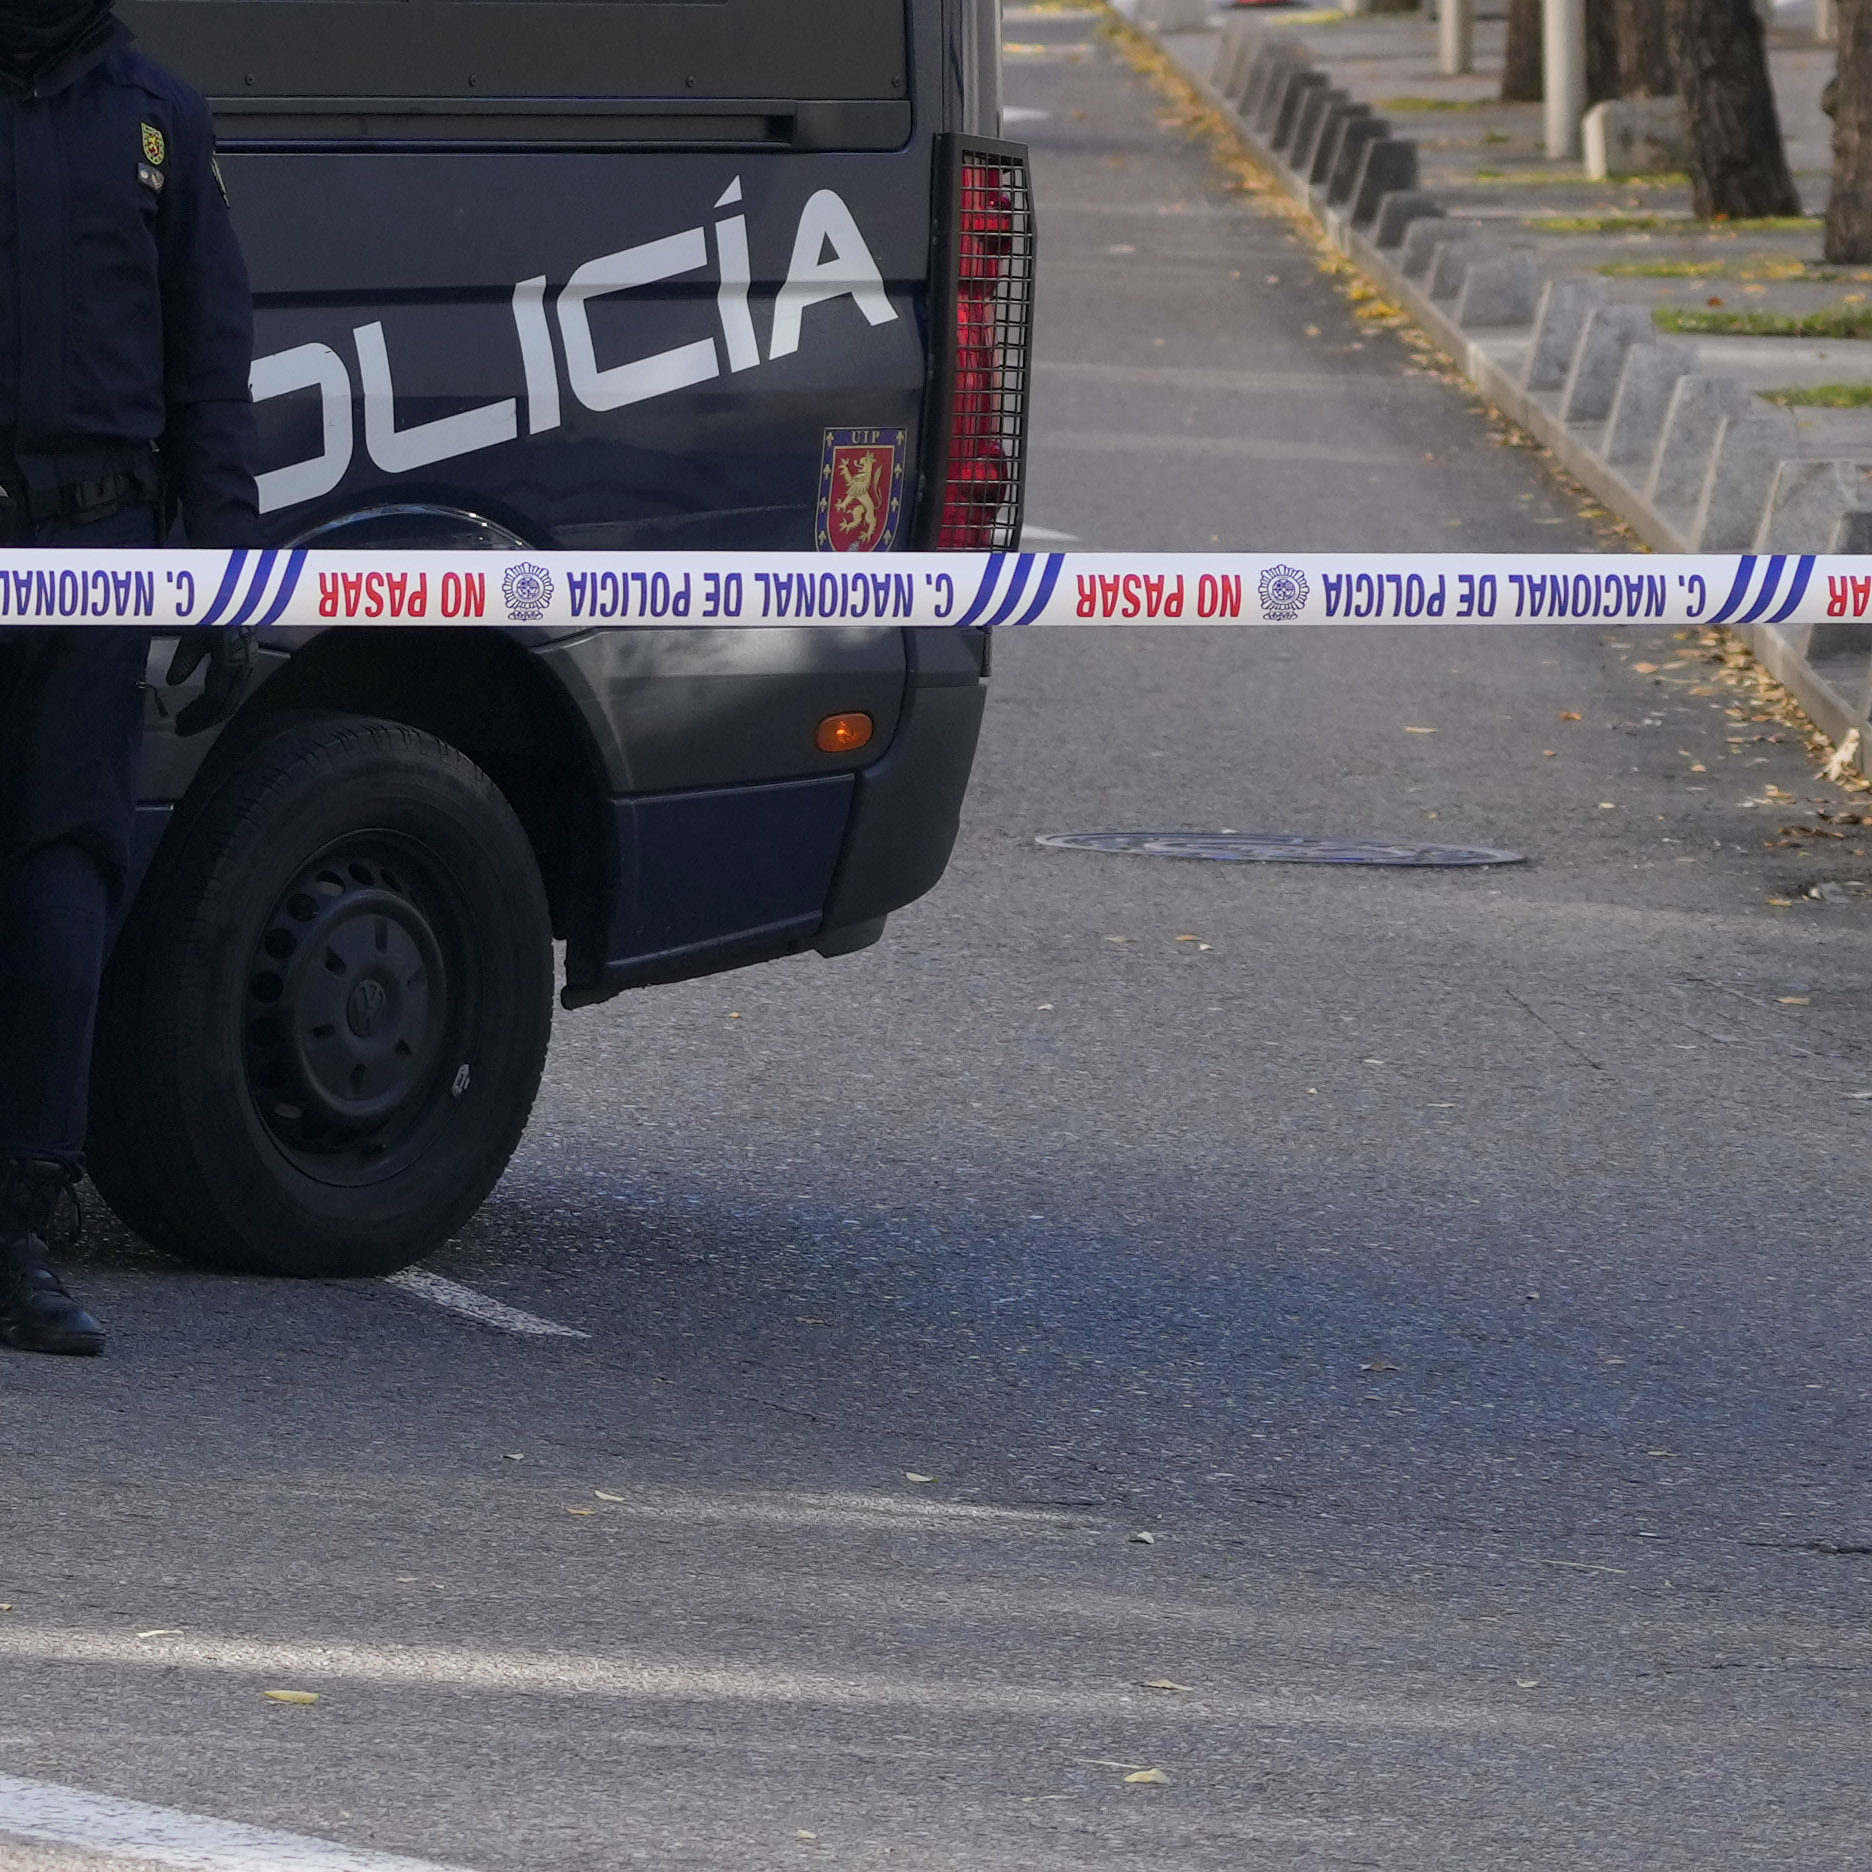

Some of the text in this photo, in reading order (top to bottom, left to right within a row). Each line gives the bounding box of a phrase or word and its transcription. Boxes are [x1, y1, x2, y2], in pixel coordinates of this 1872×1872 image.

[248, 174, 899, 515] OLICÍA
[851, 430, 881, 445] UIP
[166, 569, 195, 616] C.
[319, 573, 486, 618] NO PASAR
[567, 571, 954, 618] C. NACIONAL DE POLICIA
[1076, 575, 1242, 618] NO PASAR
[1321, 573, 1707, 618] C. NACIONAL DE POLICIA
